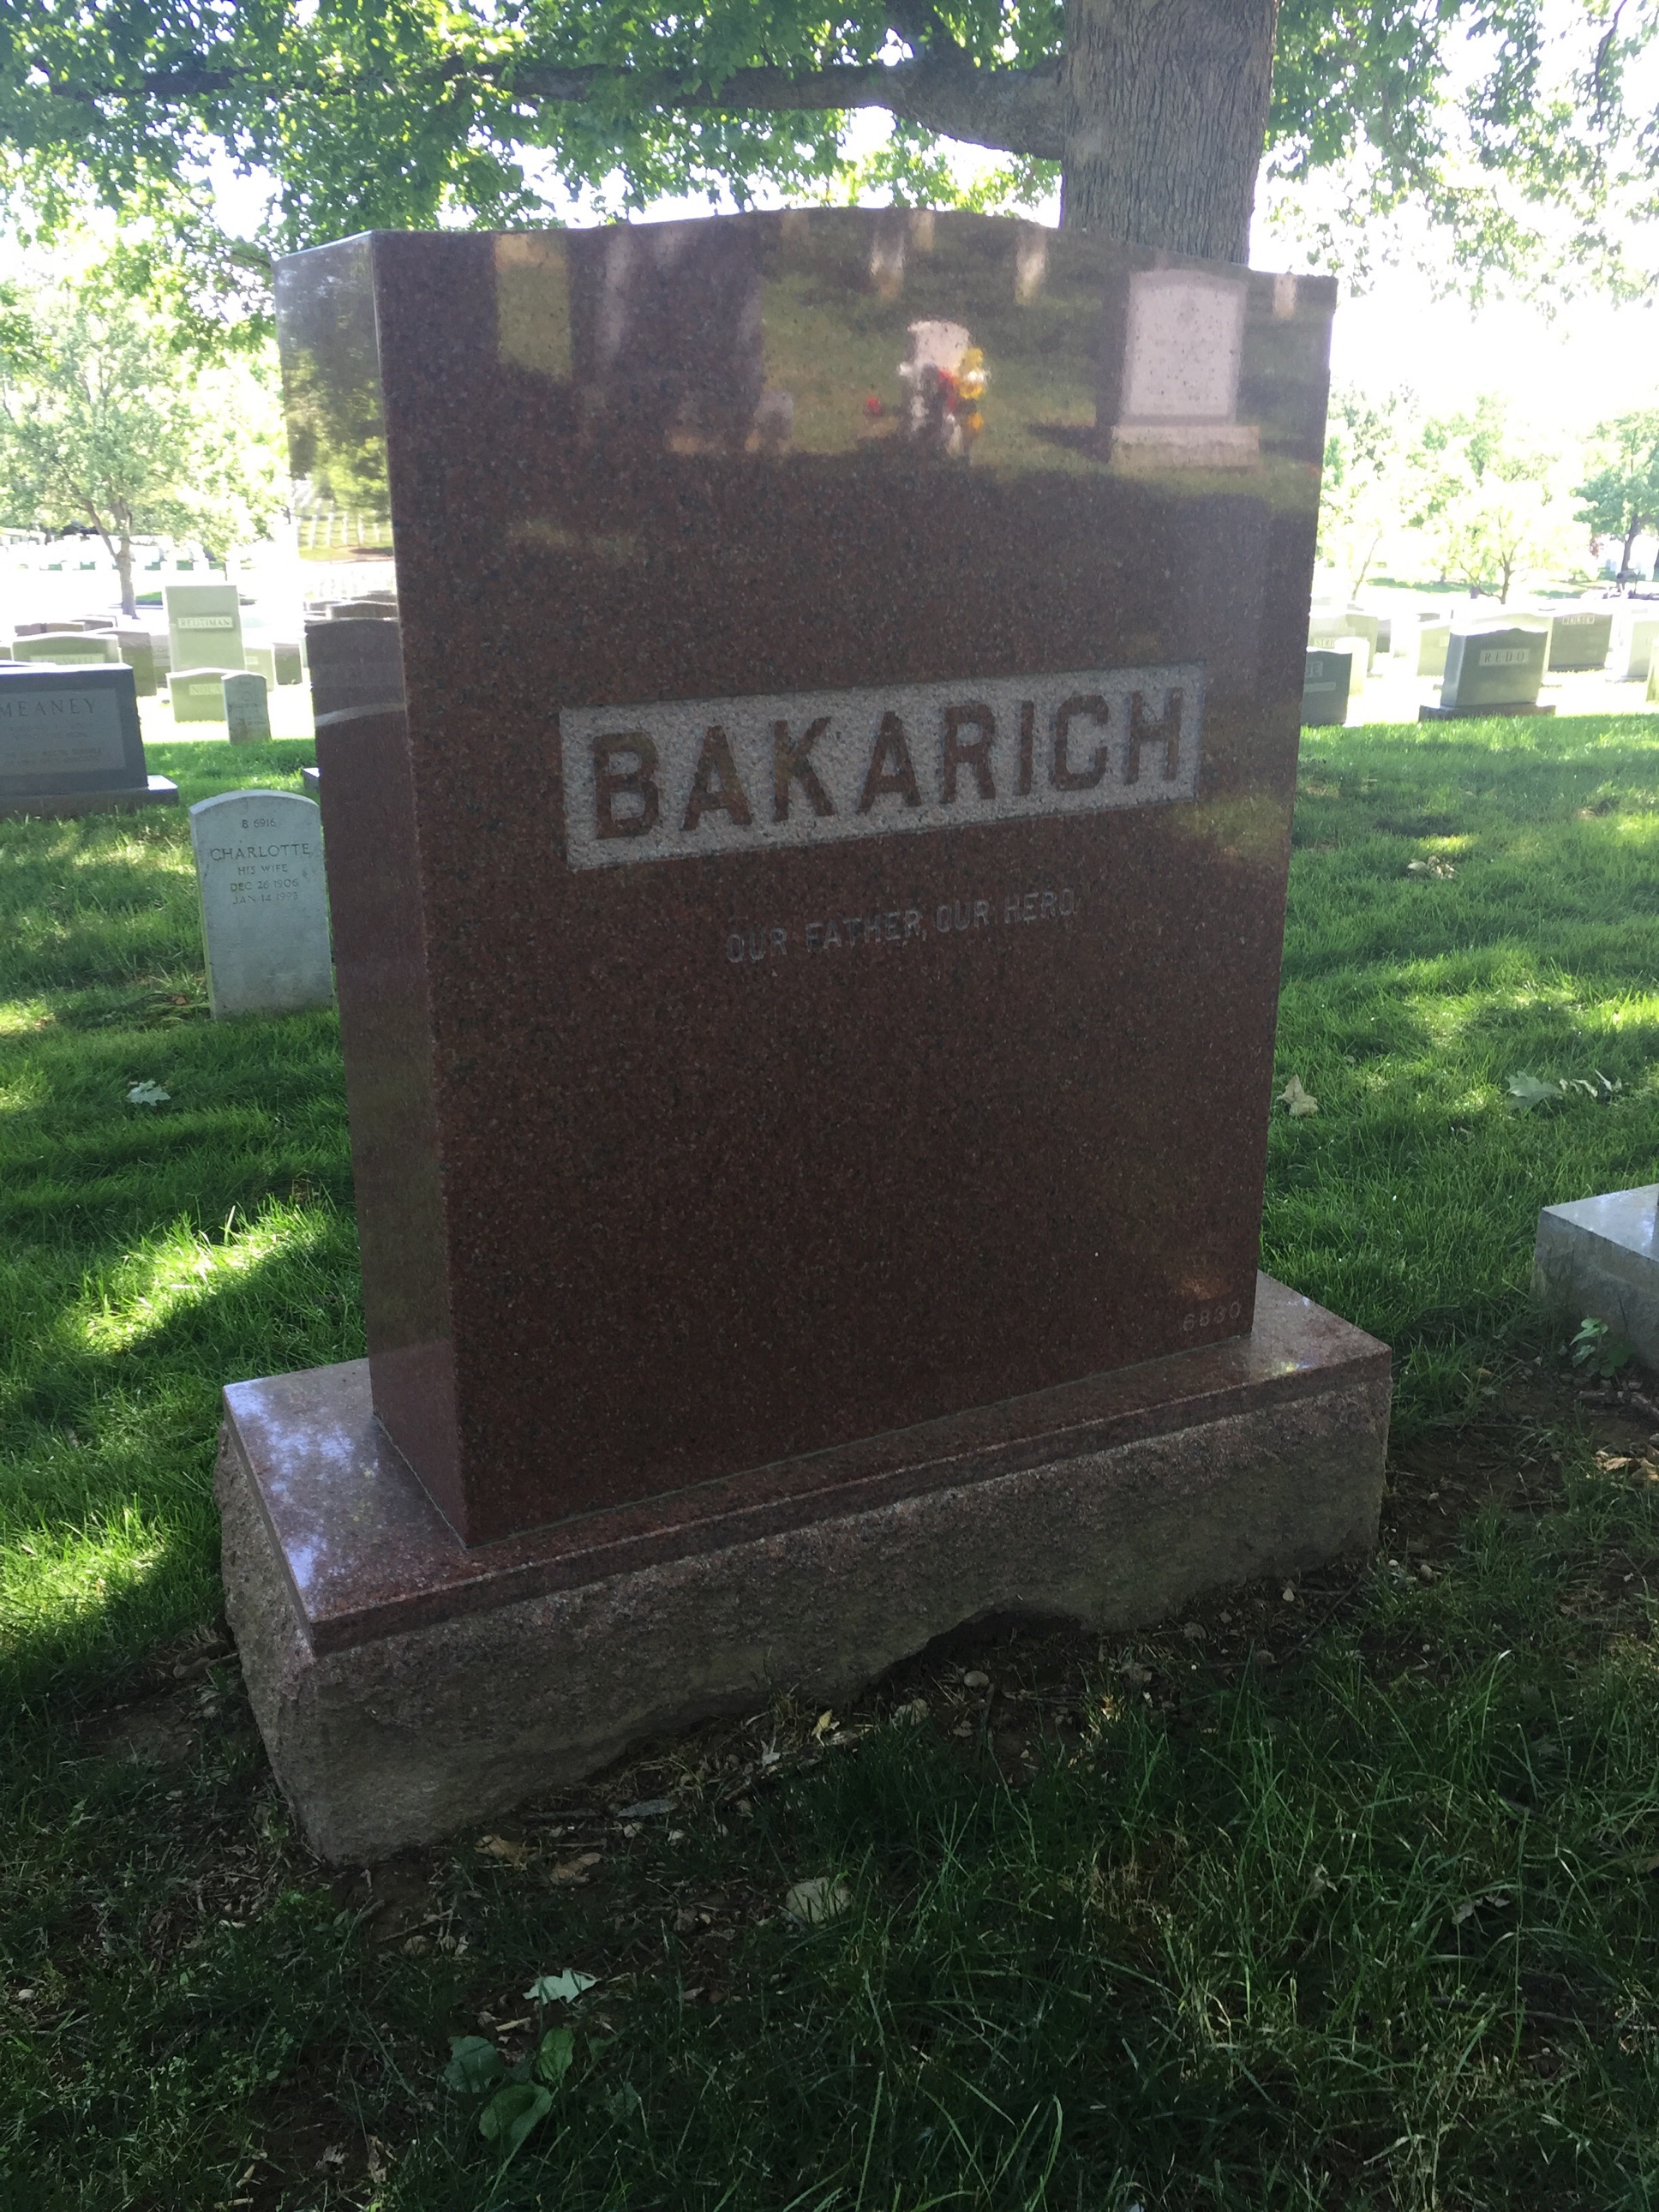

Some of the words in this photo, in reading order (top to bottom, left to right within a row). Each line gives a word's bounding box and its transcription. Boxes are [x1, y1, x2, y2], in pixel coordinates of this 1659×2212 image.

[0, 698, 95, 717] MEANEY
[590, 686, 1184, 839] BAKARICH
[253, 817, 276, 827] 6916
[210, 843, 310, 861] CHARLOTTE
[237, 865, 255, 875] HIS
[261, 863, 288, 872] WIFE
[230, 881, 253, 892] DEC
[273, 878, 299, 888] 1906
[232, 896, 256, 905] JAN
[726, 927, 788, 962] OUR
[937, 899, 990, 932] OUR
